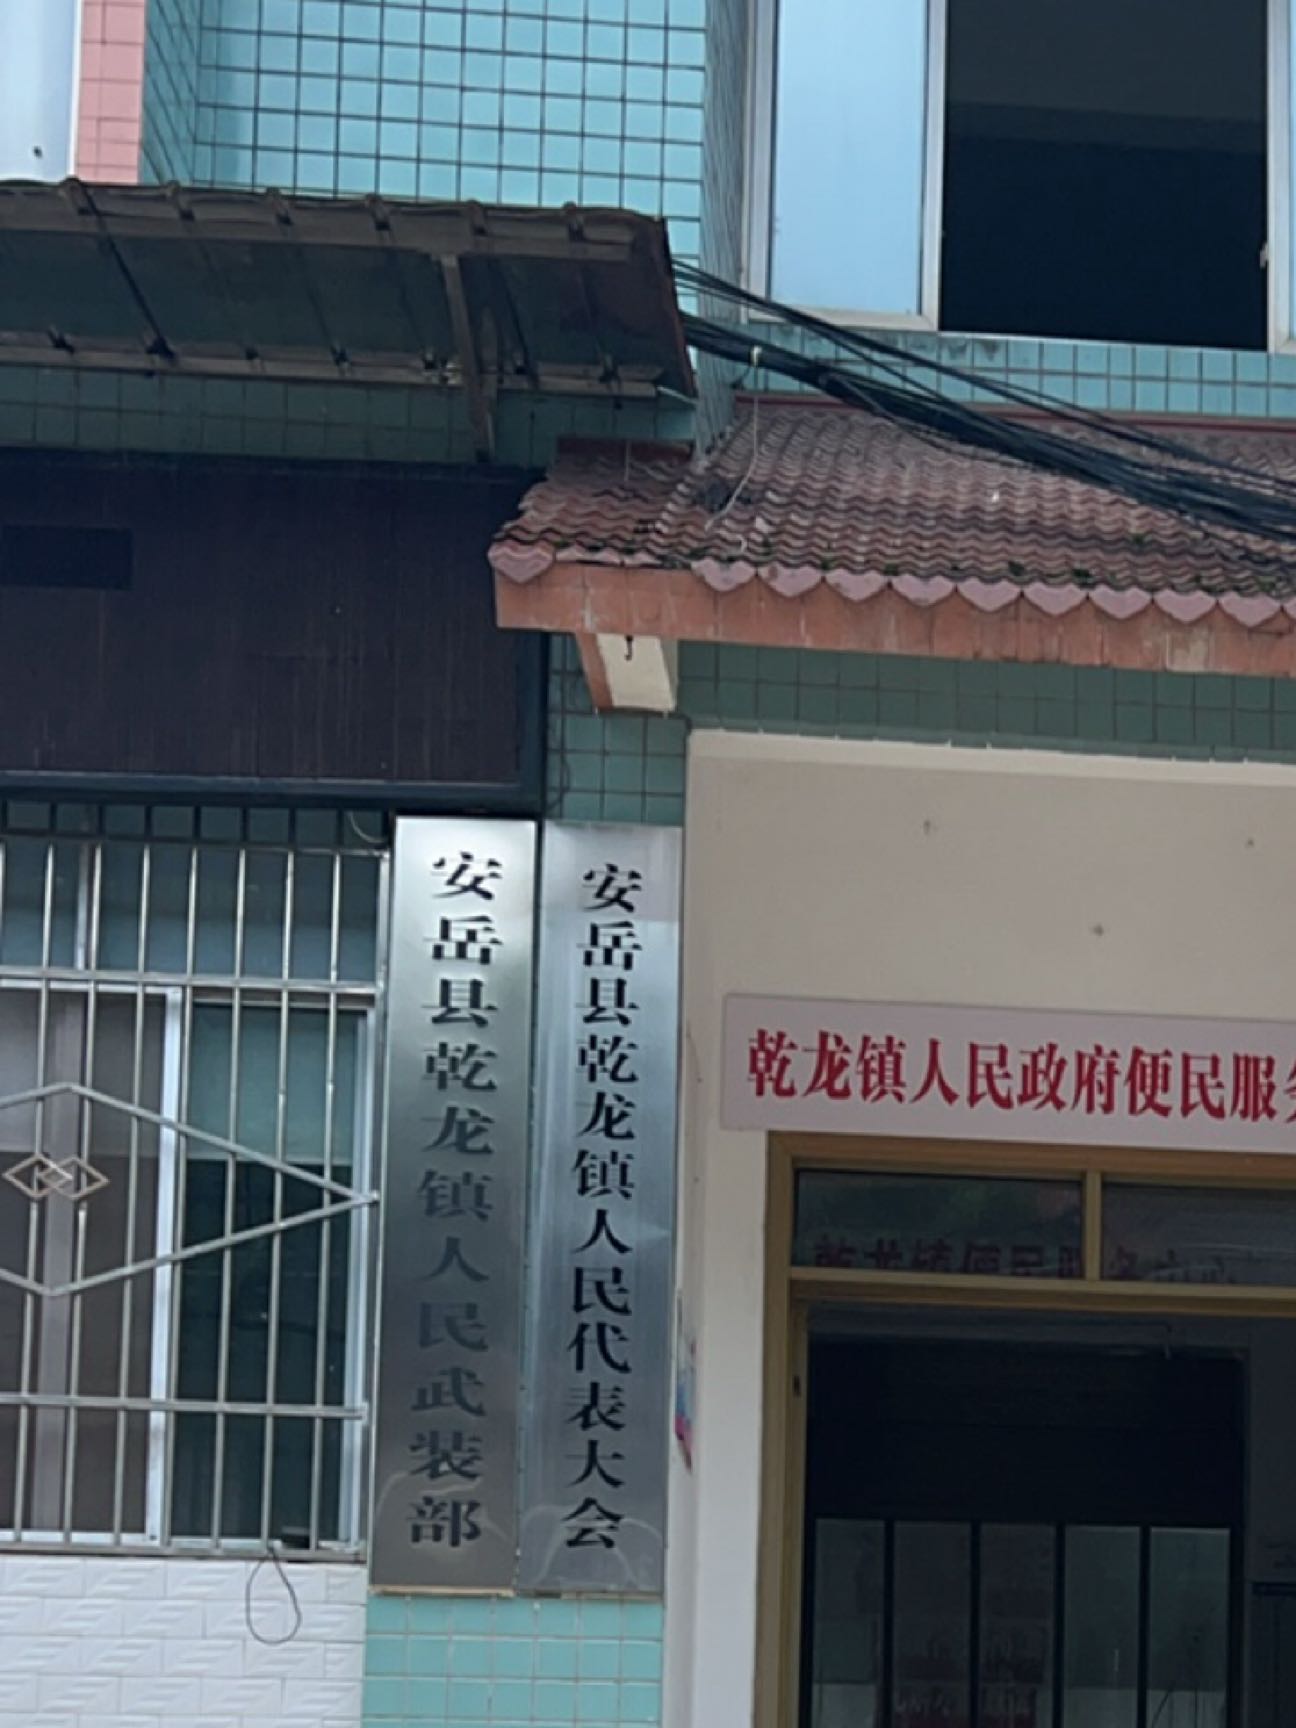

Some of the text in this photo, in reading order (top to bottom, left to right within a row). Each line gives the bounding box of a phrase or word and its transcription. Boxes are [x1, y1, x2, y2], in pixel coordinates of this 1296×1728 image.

[406, 851, 504, 1549] 安岳县乾龙镇人民武装部
[561, 863, 643, 1550] 安岳县乾龙镇人民代表大会
